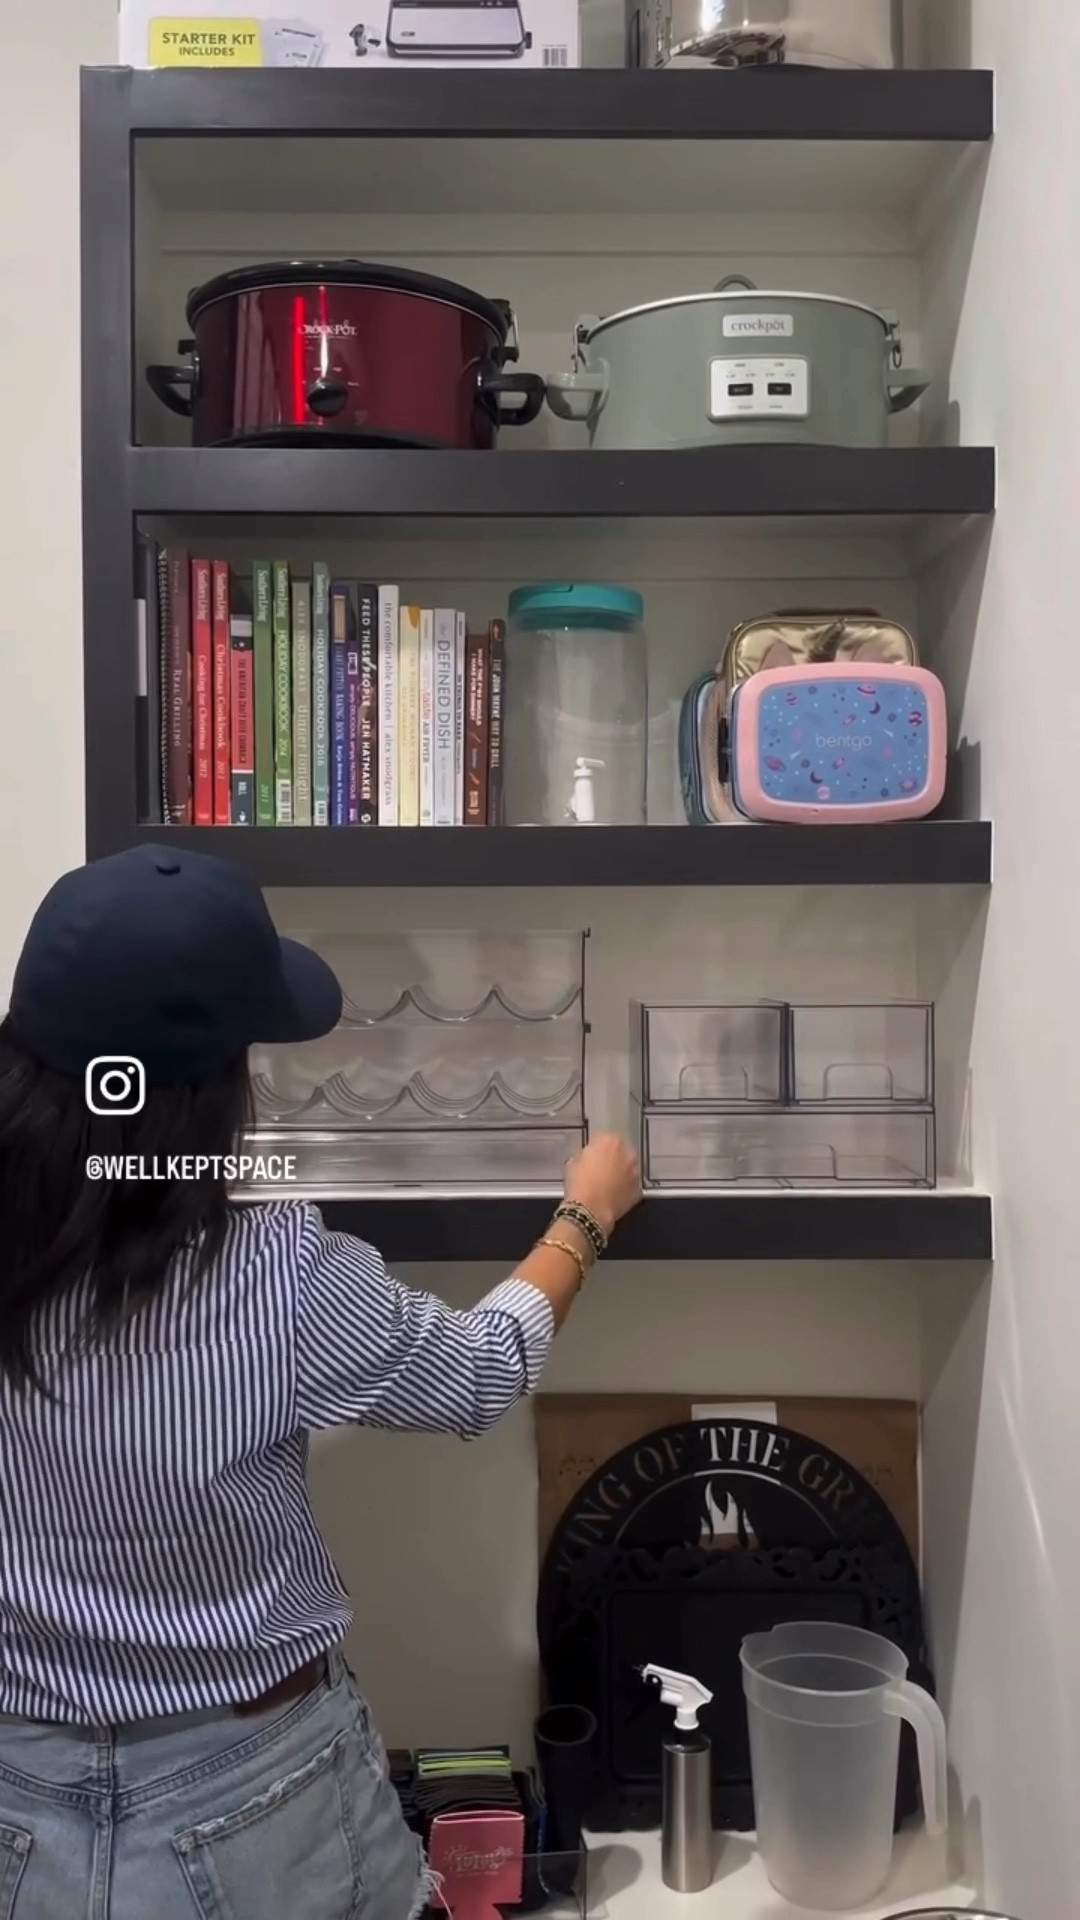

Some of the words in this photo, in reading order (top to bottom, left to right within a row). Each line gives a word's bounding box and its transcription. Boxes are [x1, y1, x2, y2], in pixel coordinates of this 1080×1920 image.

[162, 33, 227, 45] STARTER
[231, 34, 256, 45] KIT
[179, 47, 235, 56] INCLUDES
[731, 318, 785, 333] crockpot
[257, 570, 269, 600] Southern
[257, 601, 269, 622] Living
[361, 598, 371, 626] FEED
[384, 602, 393, 617] the
[278, 630, 288, 672] HOLIDAY
[316, 629, 325, 674] HOLIDAY
[361, 629, 371, 662] THESE
[384, 620, 393, 680] comfortable
[197, 654, 207, 692] Cooking
[216, 644, 226, 694] Christmas
[361, 666, 371, 707] PEOPLE
[437, 640, 451, 707] DEFINED
[492, 674, 501, 693] JOHN
[279, 674, 288, 732] COOKBOOK
[316, 678, 325, 740] COOKBOOK
[384, 683, 393, 720] kitchen
[173, 696, 182, 747] GRILLING
[199, 707, 208, 750] Christmas
[217, 696, 226, 749] Cookbook
[298, 704, 308, 749] dinner
[361, 718, 371, 737] JEN
[437, 712, 451, 750] DISH
[384, 732, 393, 754] alex
[491, 748, 500, 768] GRILL
[815, 733, 873, 751] bentgo
[295, 754, 309, 801] tonight
[361, 741, 371, 800] HATMAKER
[383, 756, 394, 806] snodgrass
[633, 1432, 684, 1482] OF
[700, 1427, 790, 1471] THE
